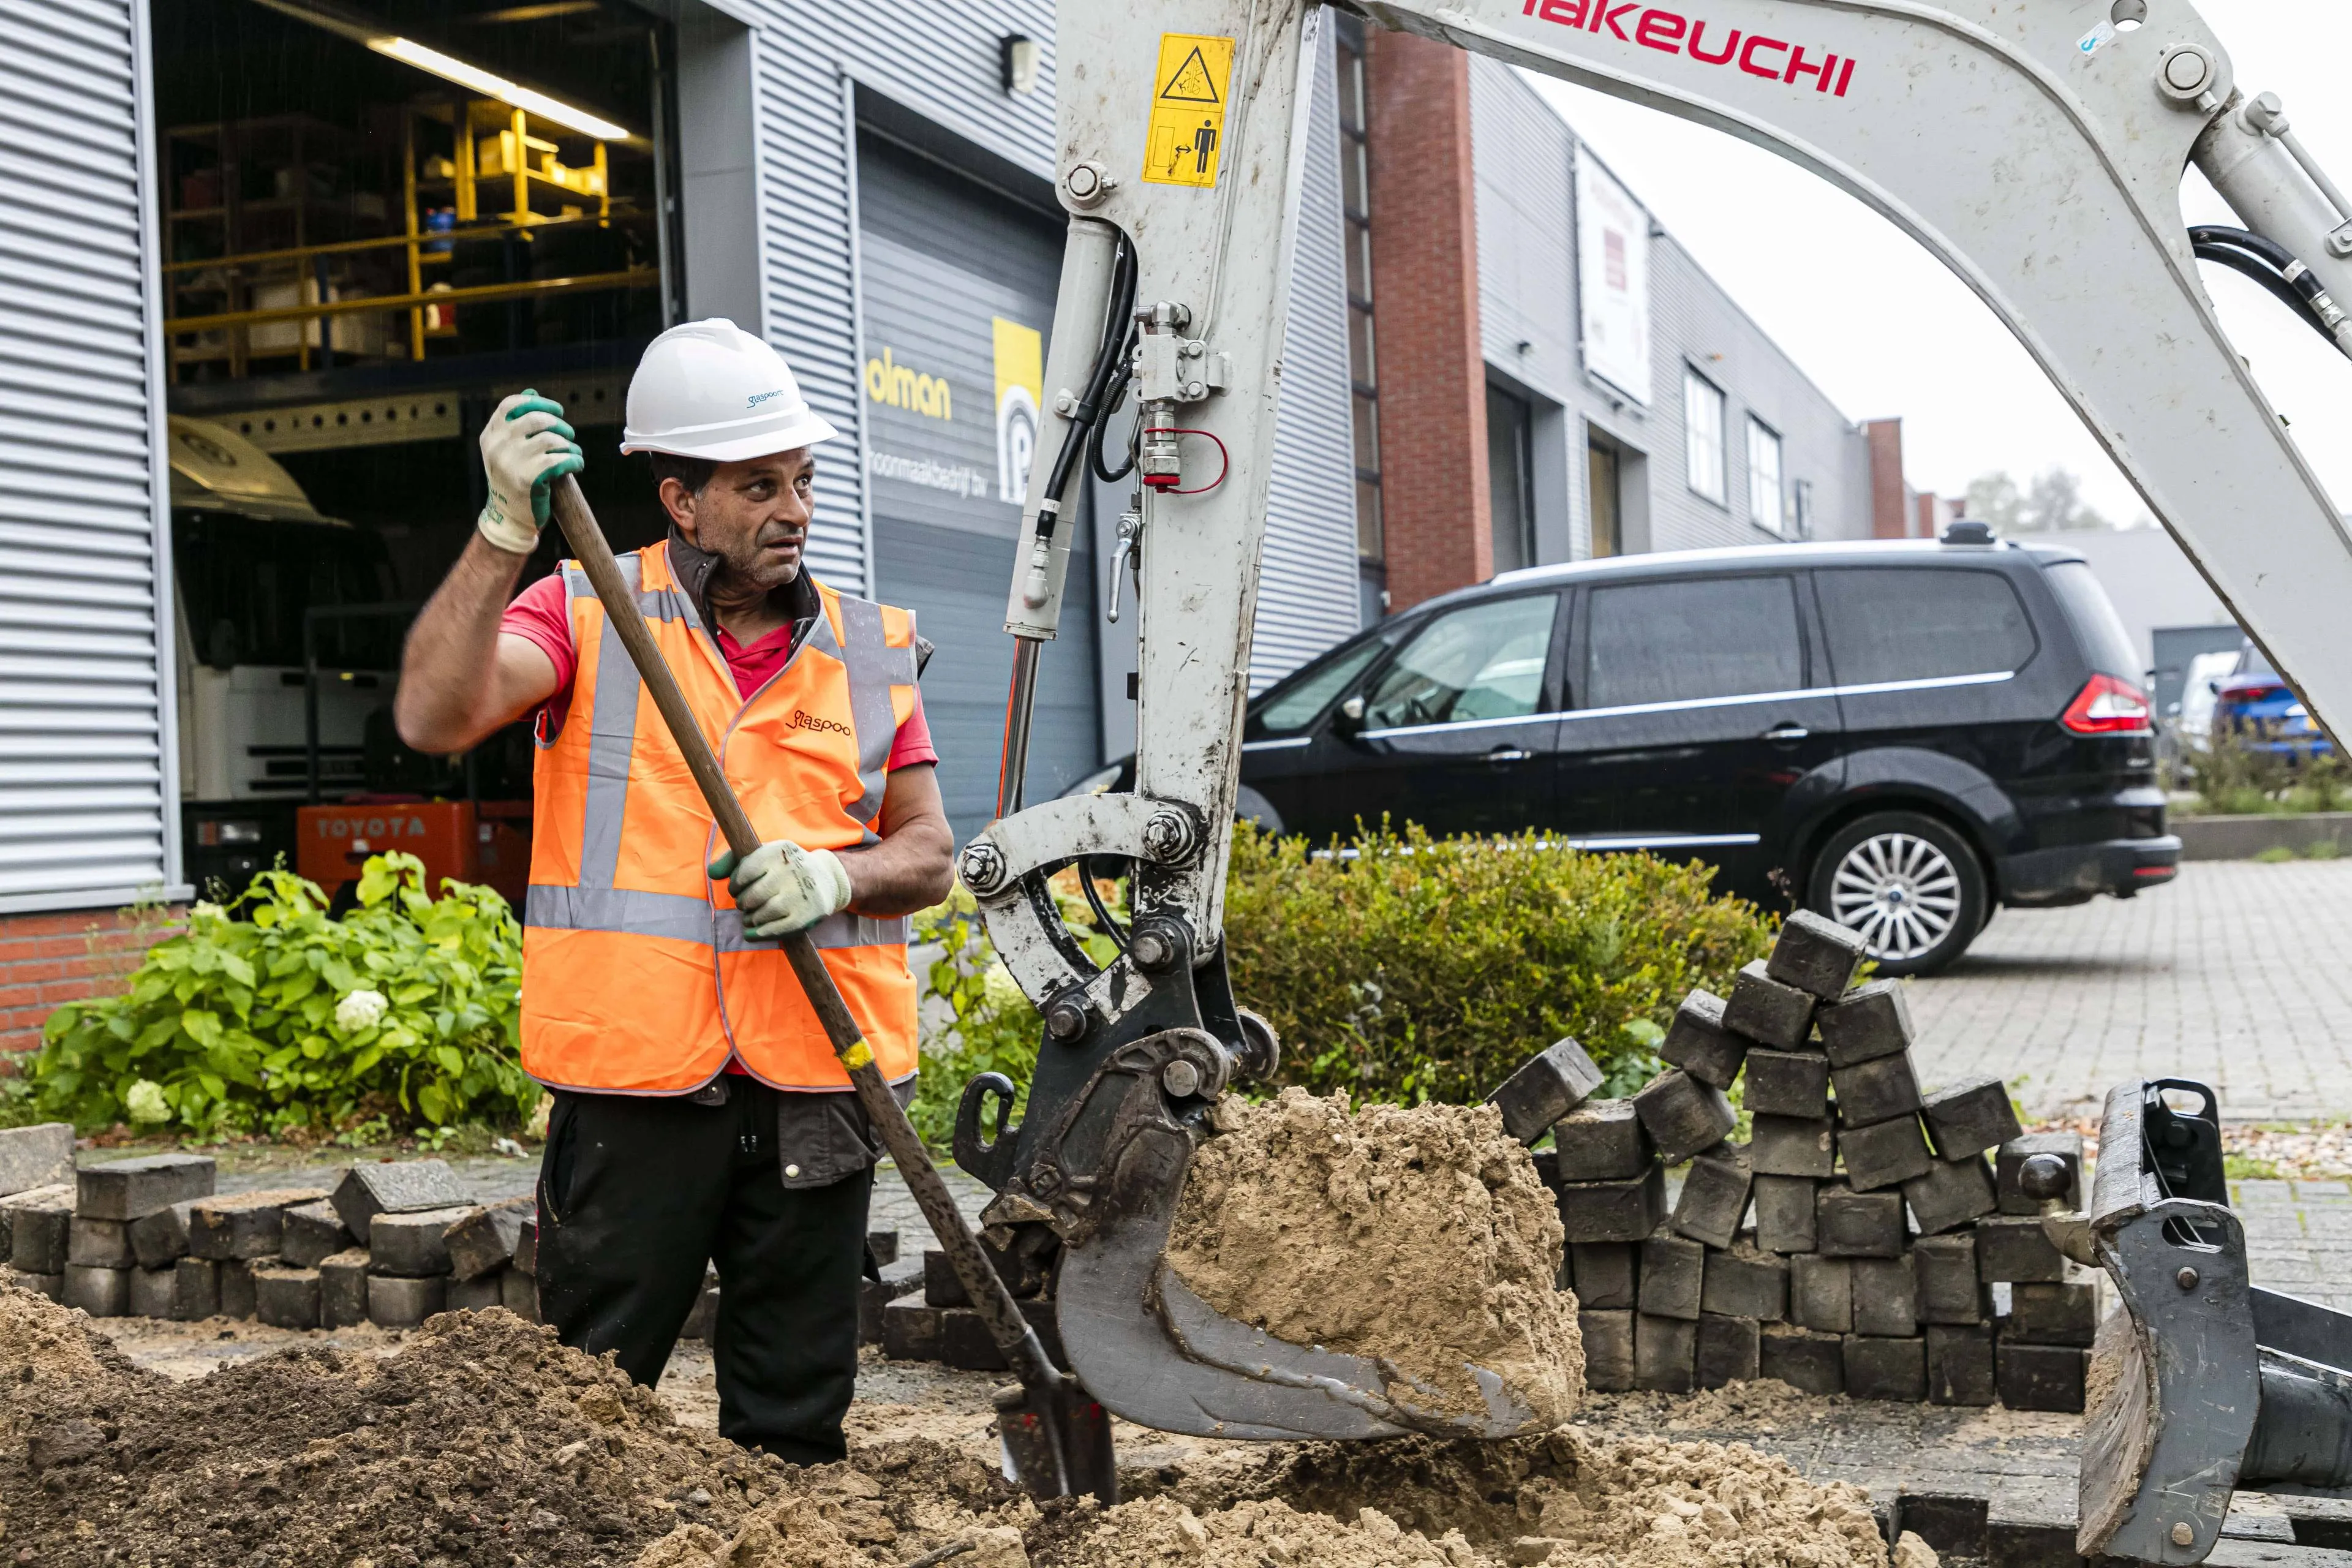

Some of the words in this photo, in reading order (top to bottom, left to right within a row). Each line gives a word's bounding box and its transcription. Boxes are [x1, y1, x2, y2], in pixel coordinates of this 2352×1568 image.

[866, 345, 951, 421] olman
[785, 710, 852, 739] glaspoo
[317, 816, 426, 839] TOYOTA
